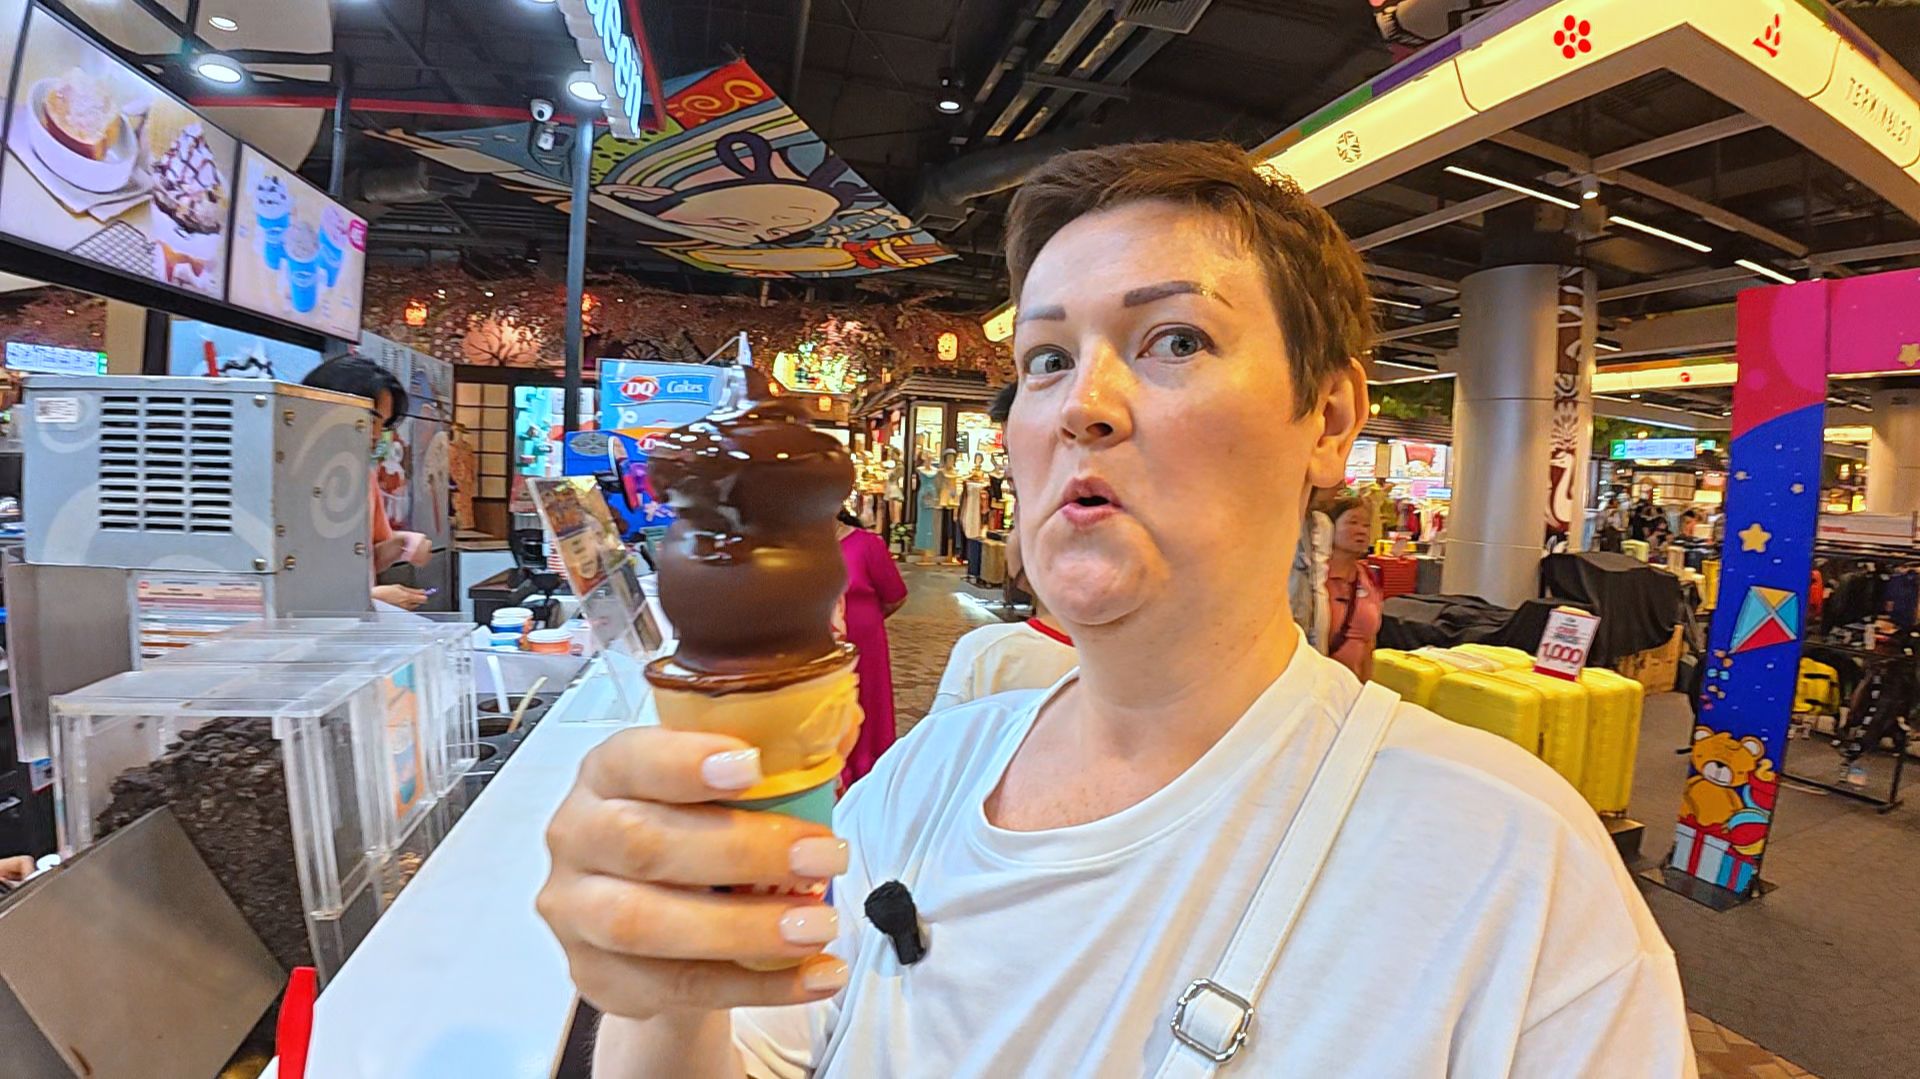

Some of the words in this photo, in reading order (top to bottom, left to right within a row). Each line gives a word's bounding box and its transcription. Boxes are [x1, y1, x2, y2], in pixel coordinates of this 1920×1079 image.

[626, 381, 655, 396] DQ
[666, 380, 704, 393] Cakes
[1541, 642, 1584, 665] 1,000
